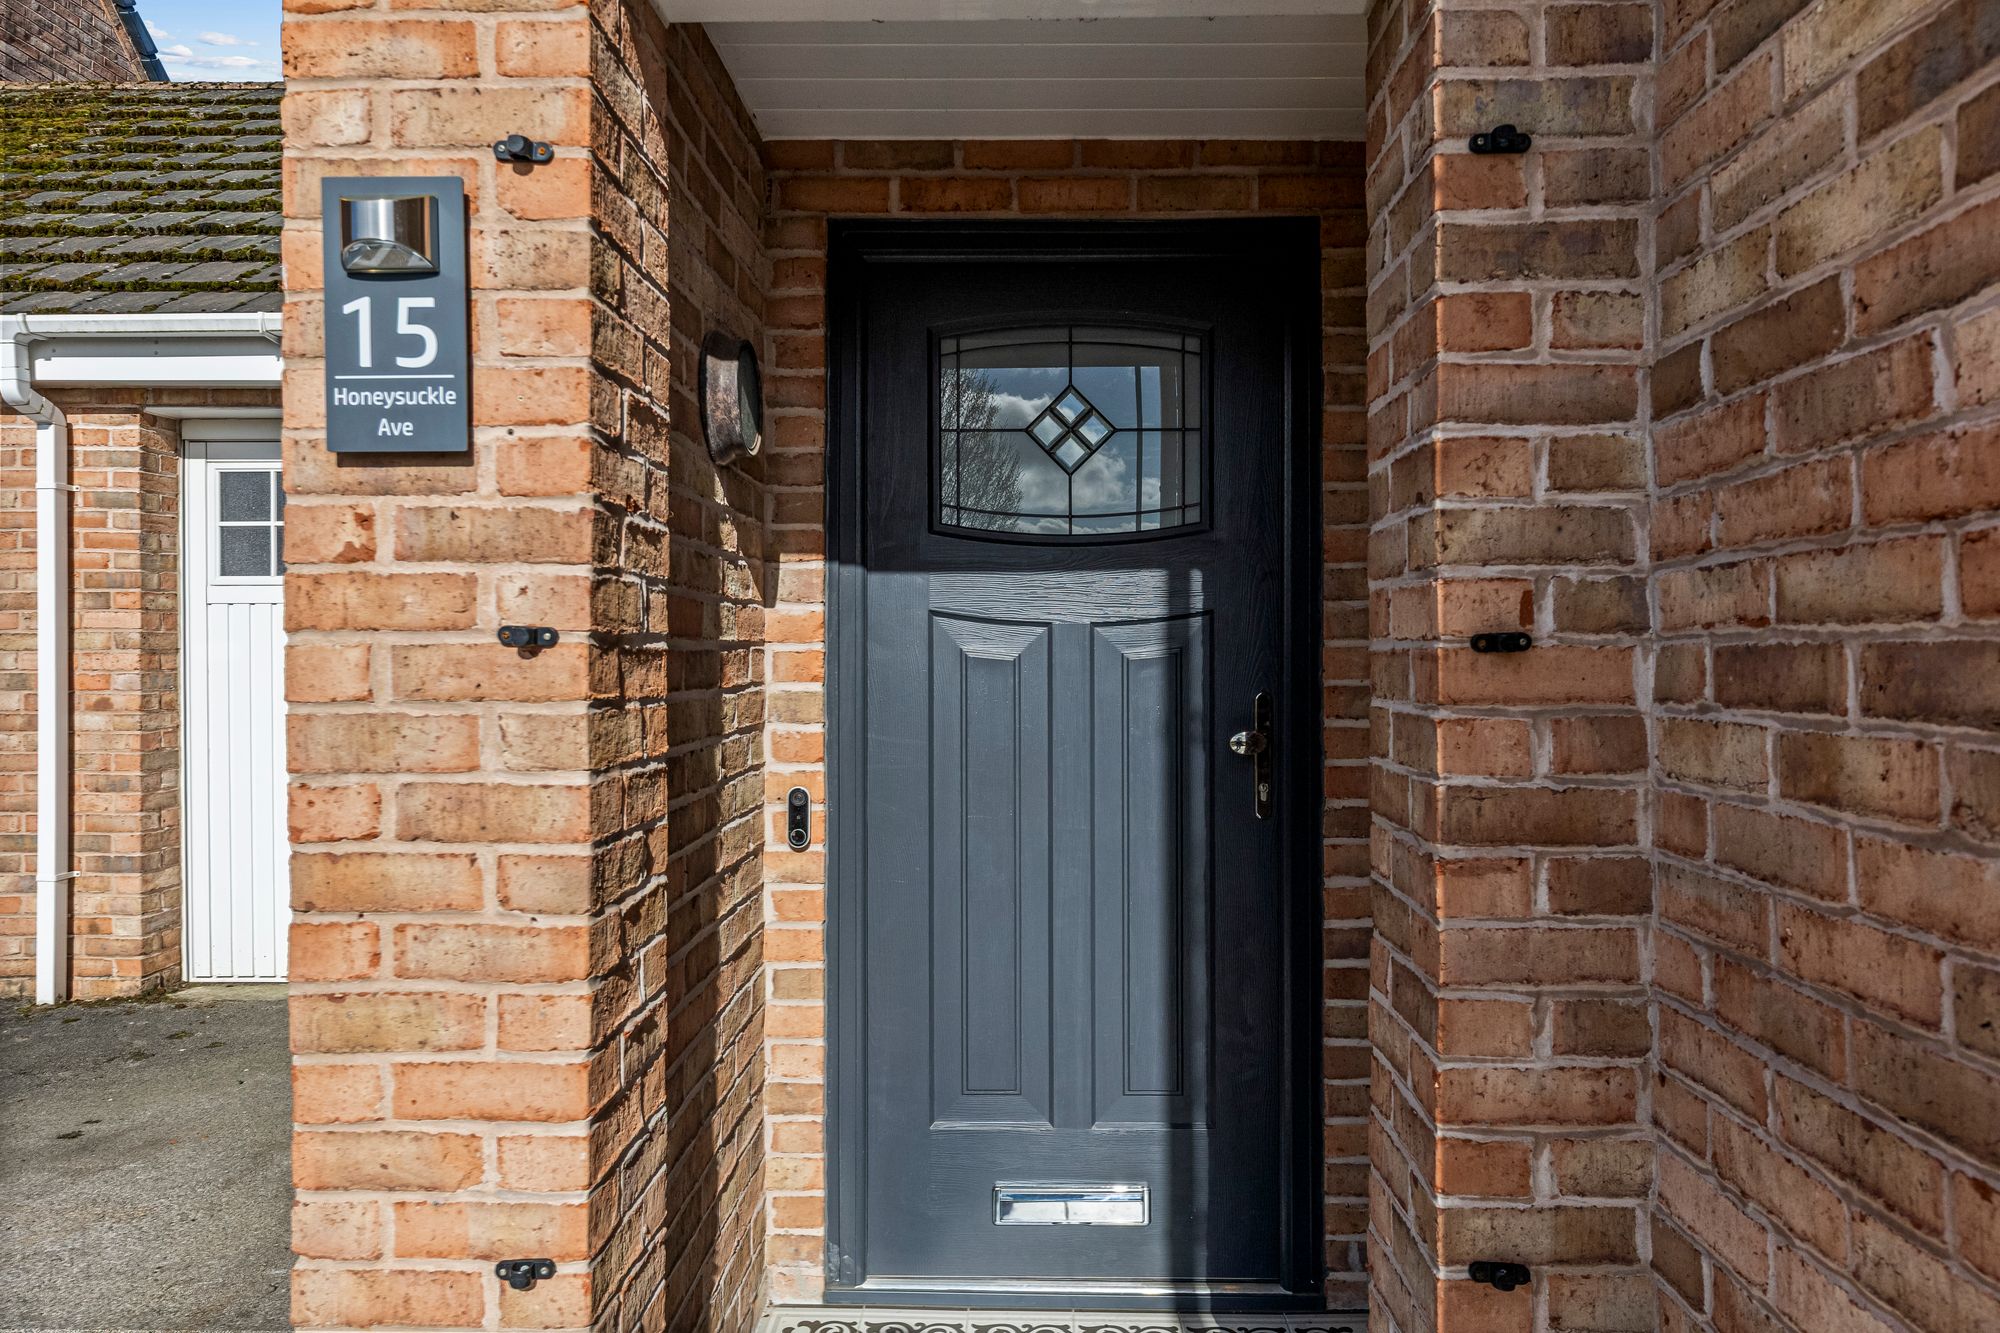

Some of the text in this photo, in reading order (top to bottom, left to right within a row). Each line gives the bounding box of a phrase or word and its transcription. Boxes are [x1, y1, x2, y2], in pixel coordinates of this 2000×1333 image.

[342, 296, 438, 368] 15
[334, 386, 457, 409] Honeysuckle
[378, 418, 414, 436] Ave
